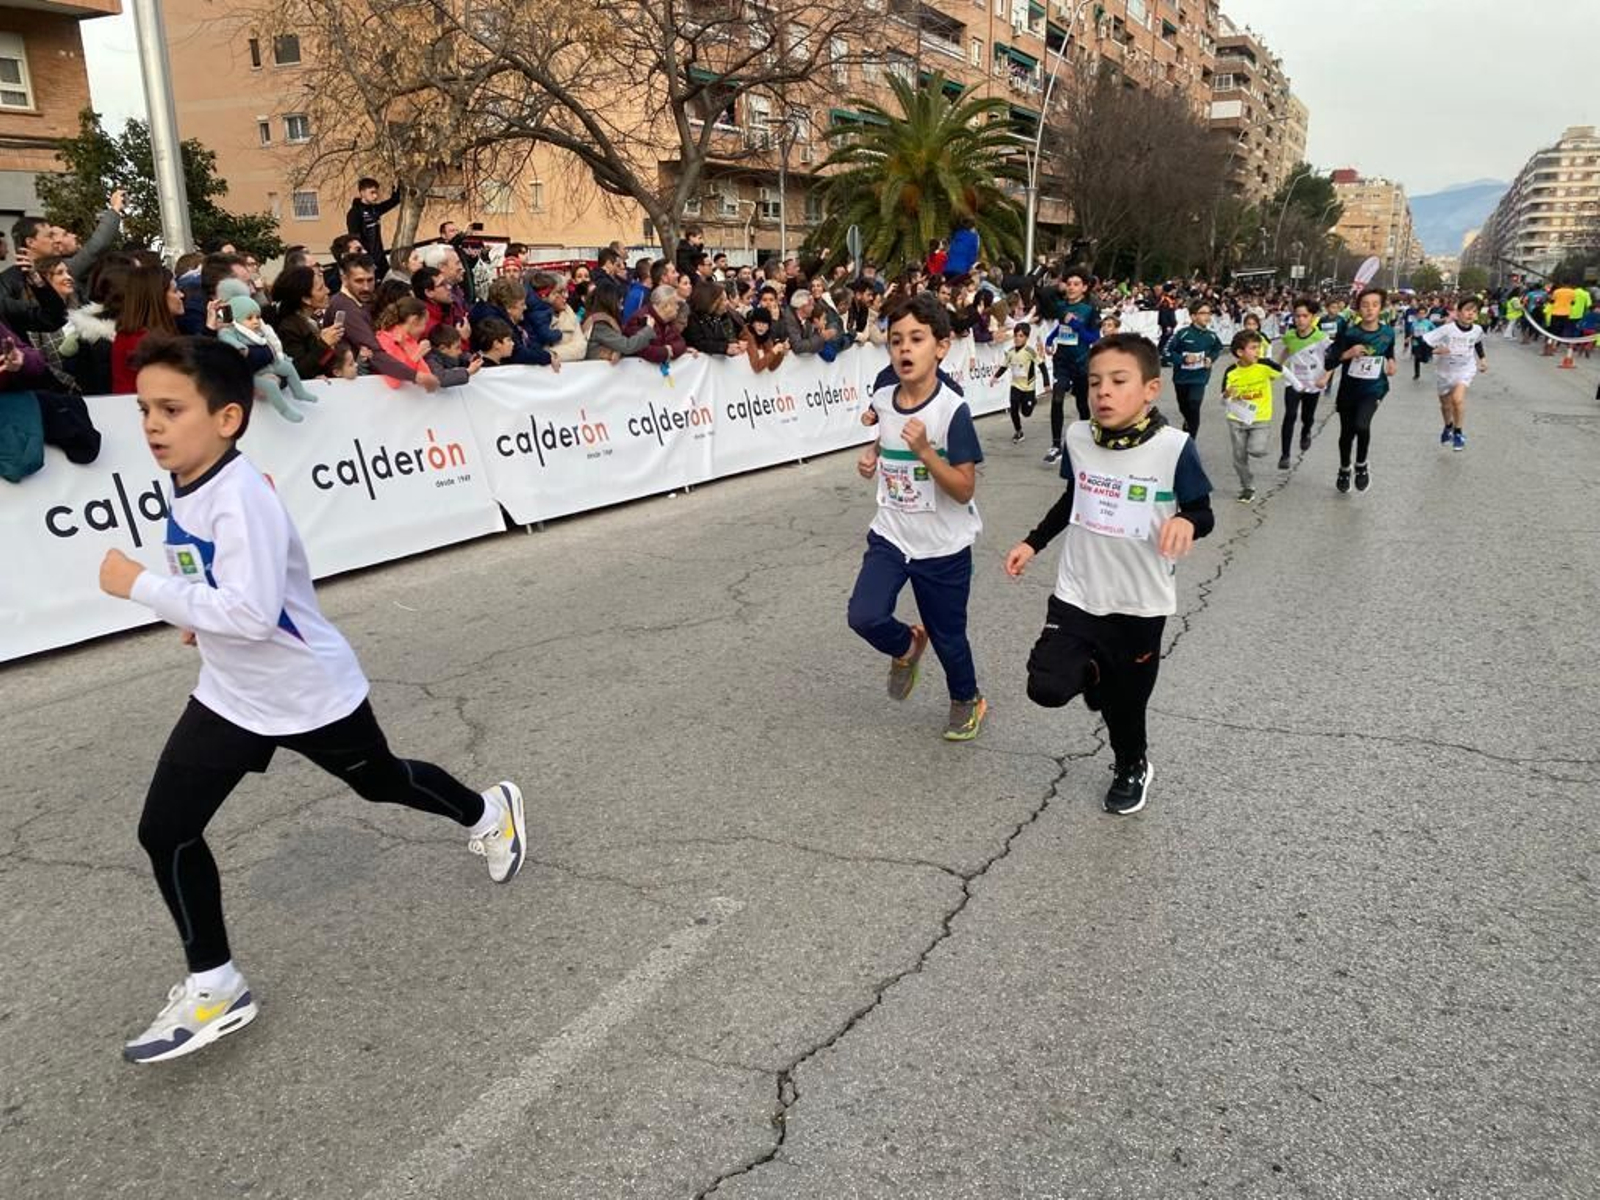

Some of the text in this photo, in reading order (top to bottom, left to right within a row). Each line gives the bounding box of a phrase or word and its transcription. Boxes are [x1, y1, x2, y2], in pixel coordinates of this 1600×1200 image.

[628, 396, 713, 447] calderón
[727, 385, 796, 430] calderón
[805, 378, 859, 416] calderón
[311, 428, 466, 500] calderón
[496, 409, 610, 467] calderón
[45, 472, 169, 548] cald
